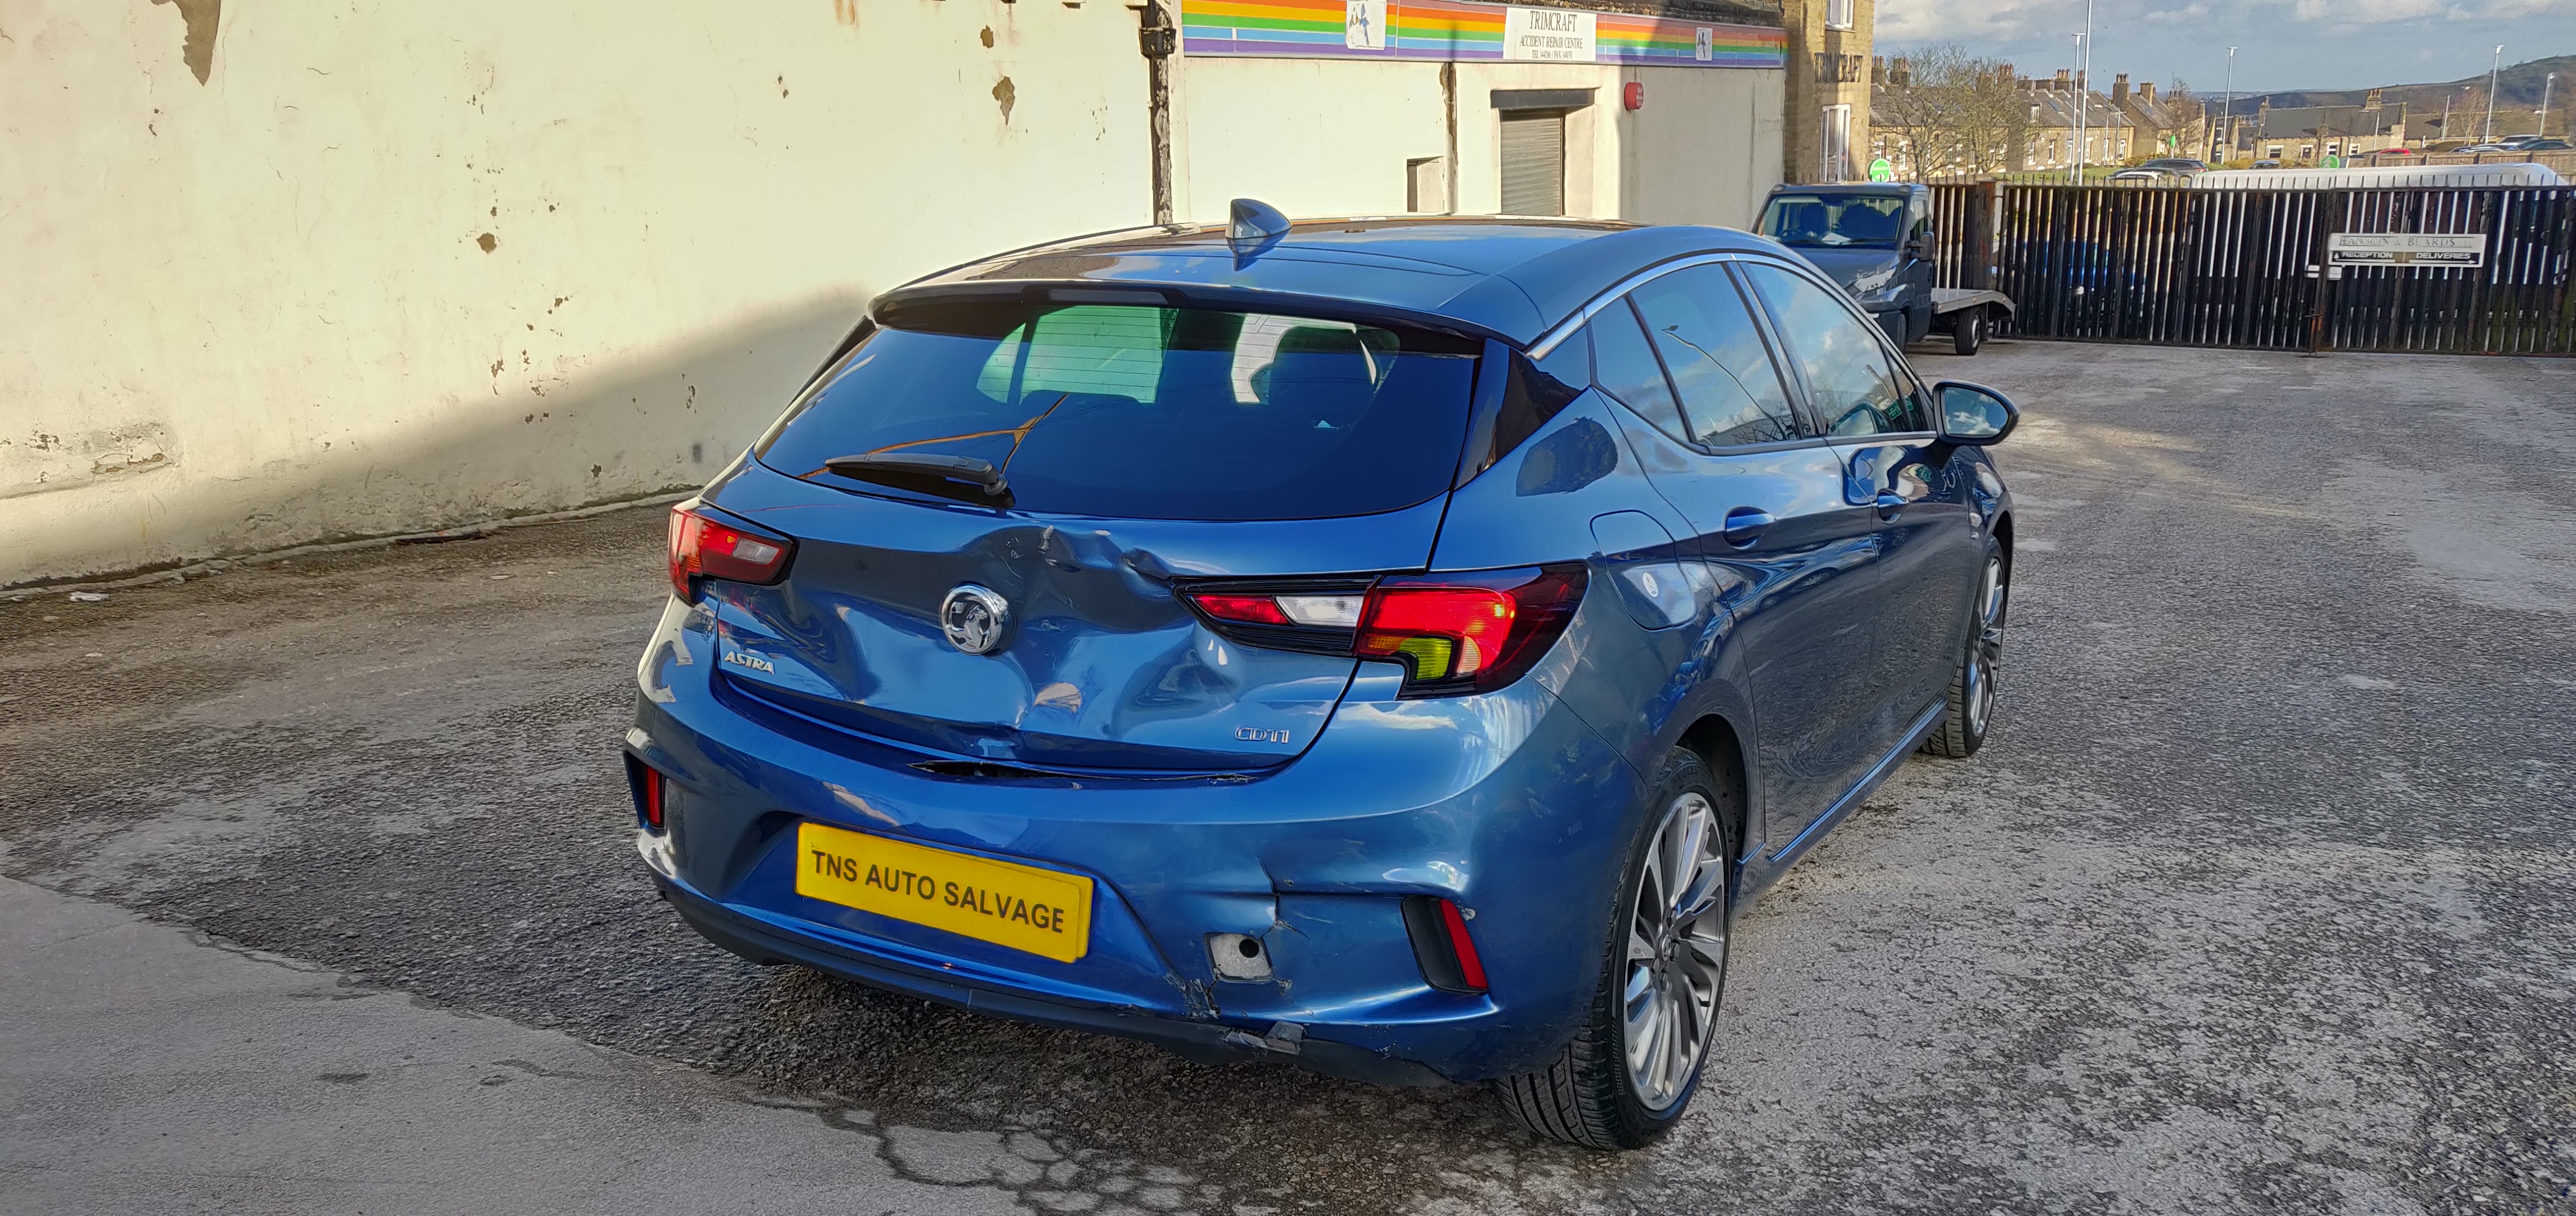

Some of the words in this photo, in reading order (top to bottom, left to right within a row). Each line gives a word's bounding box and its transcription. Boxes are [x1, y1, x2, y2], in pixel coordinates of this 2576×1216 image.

[1530, 11, 1577, 32] TRIMCRAFT
[1519, 35, 1545, 48] ACCIDENT
[1546, 36, 1564, 48] REPAIR
[1564, 37, 1583, 49] CENTRE
[1813, 53, 1863, 83] TRIMCRAFT
[2339, 237, 2389, 246] HANSON
[2408, 238, 2455, 246] BEARDS
[724, 650, 775, 675] ASTRA
[1234, 726, 1290, 743] CDTI
[811, 849, 858, 882] TNS
[865, 863, 936, 900] AUTO
[944, 881, 1064, 934] SALVAGE
